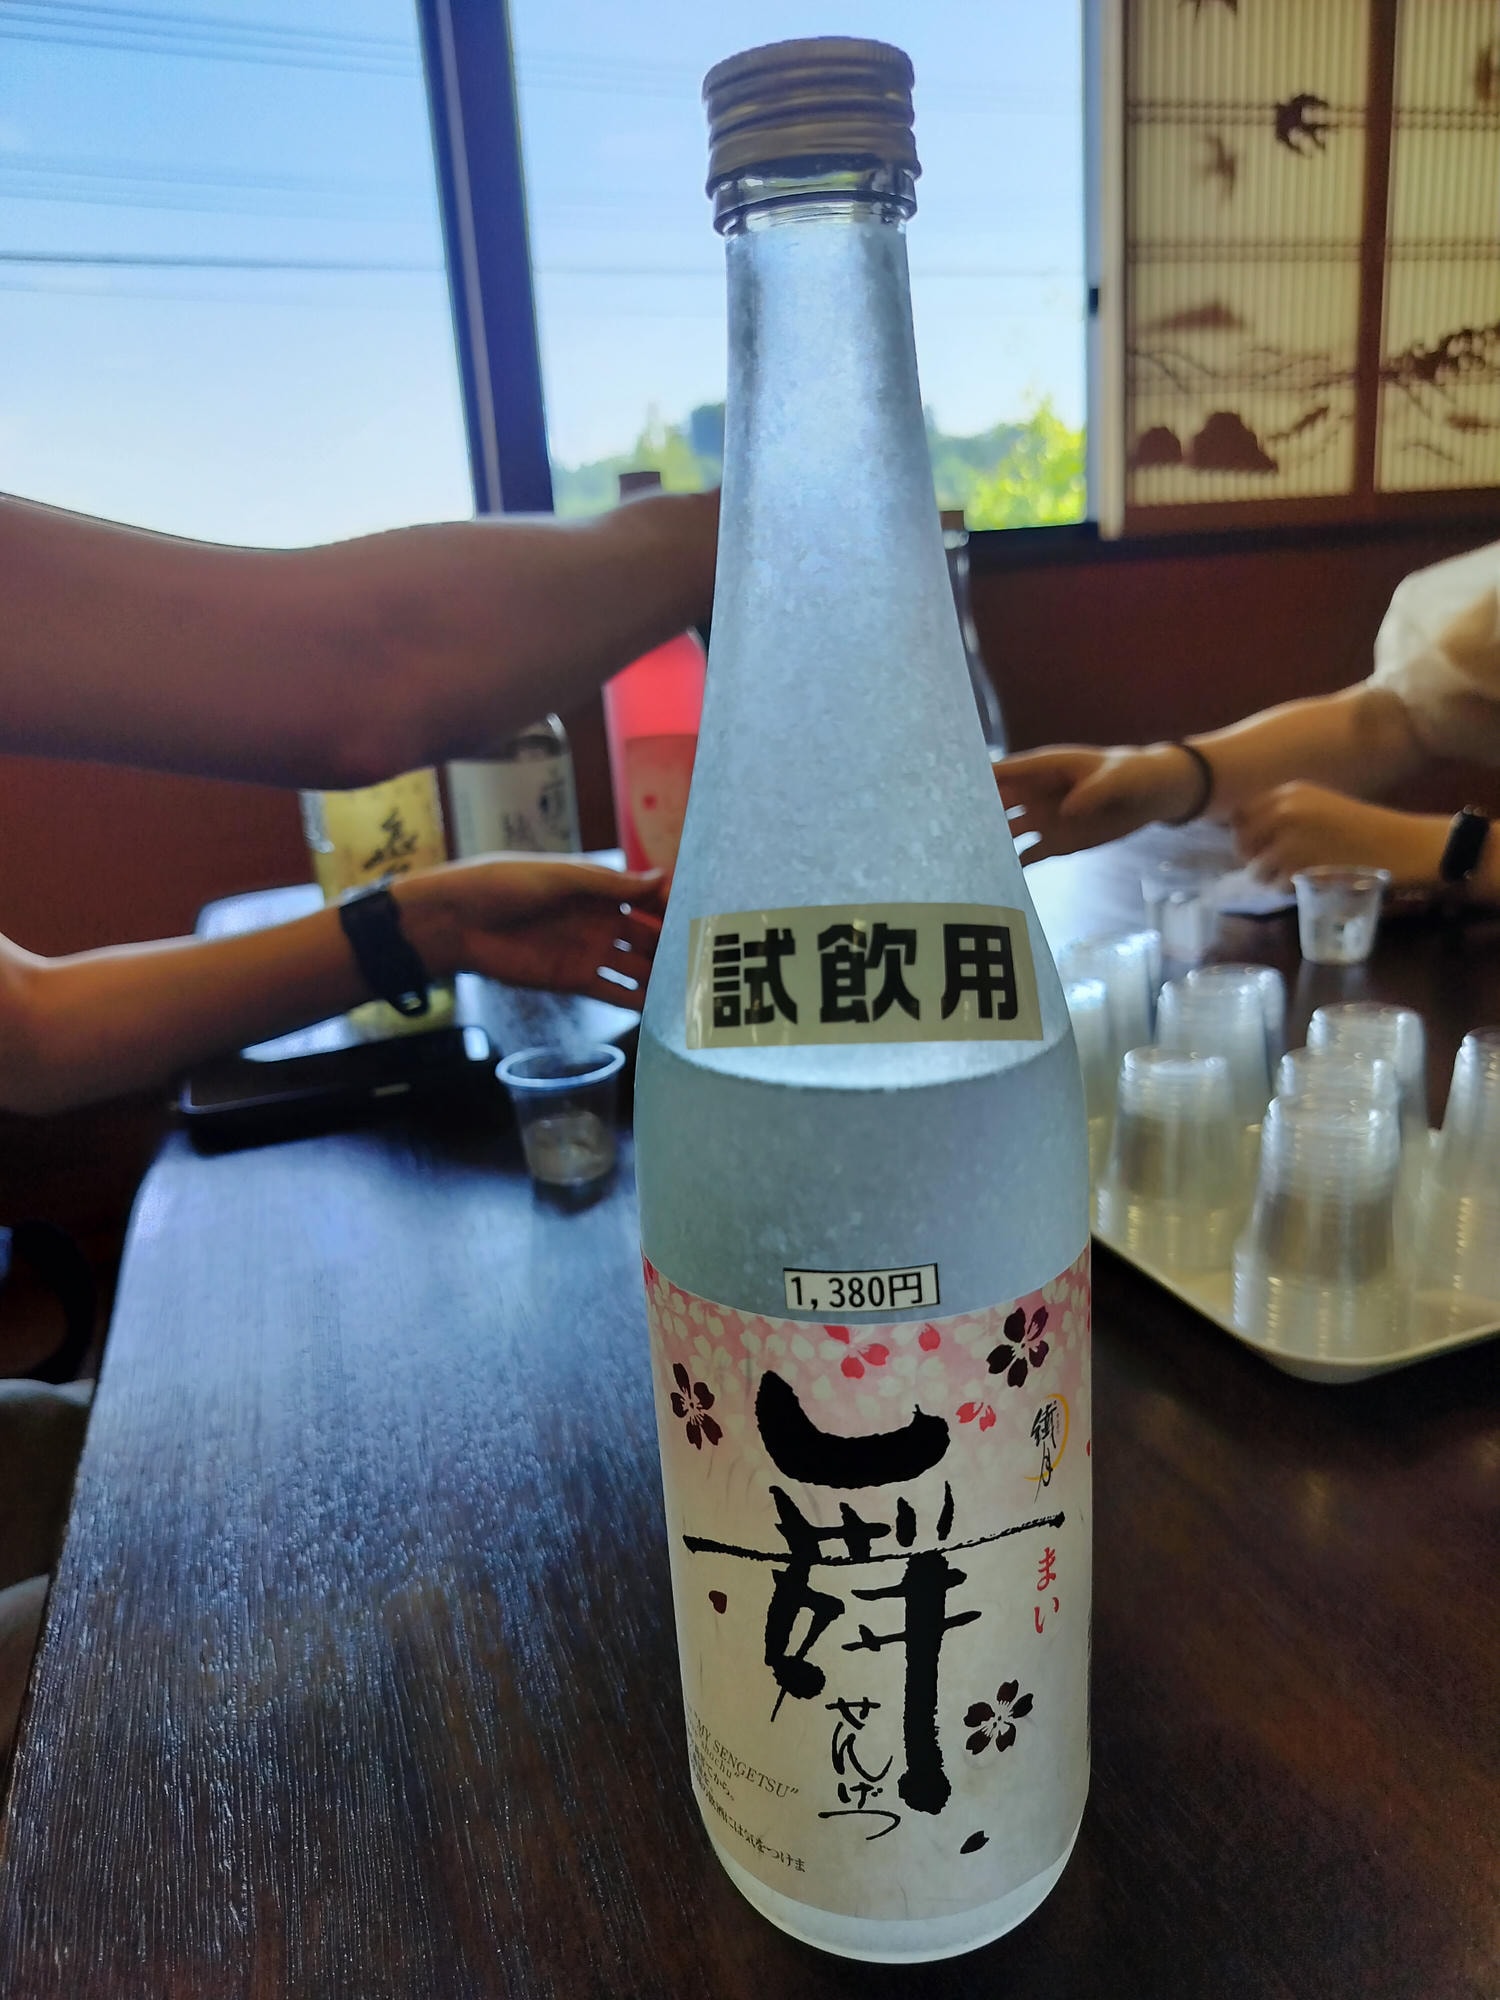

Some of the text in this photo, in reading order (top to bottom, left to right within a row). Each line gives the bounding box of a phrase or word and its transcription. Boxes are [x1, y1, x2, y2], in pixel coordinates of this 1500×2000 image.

[712, 922, 1019, 1028] 試飲用
[790, 1271, 923, 1311] 1,380円
[1033, 1546, 1060, 1634] まい
[817, 1696, 902, 1841] せんげつ
